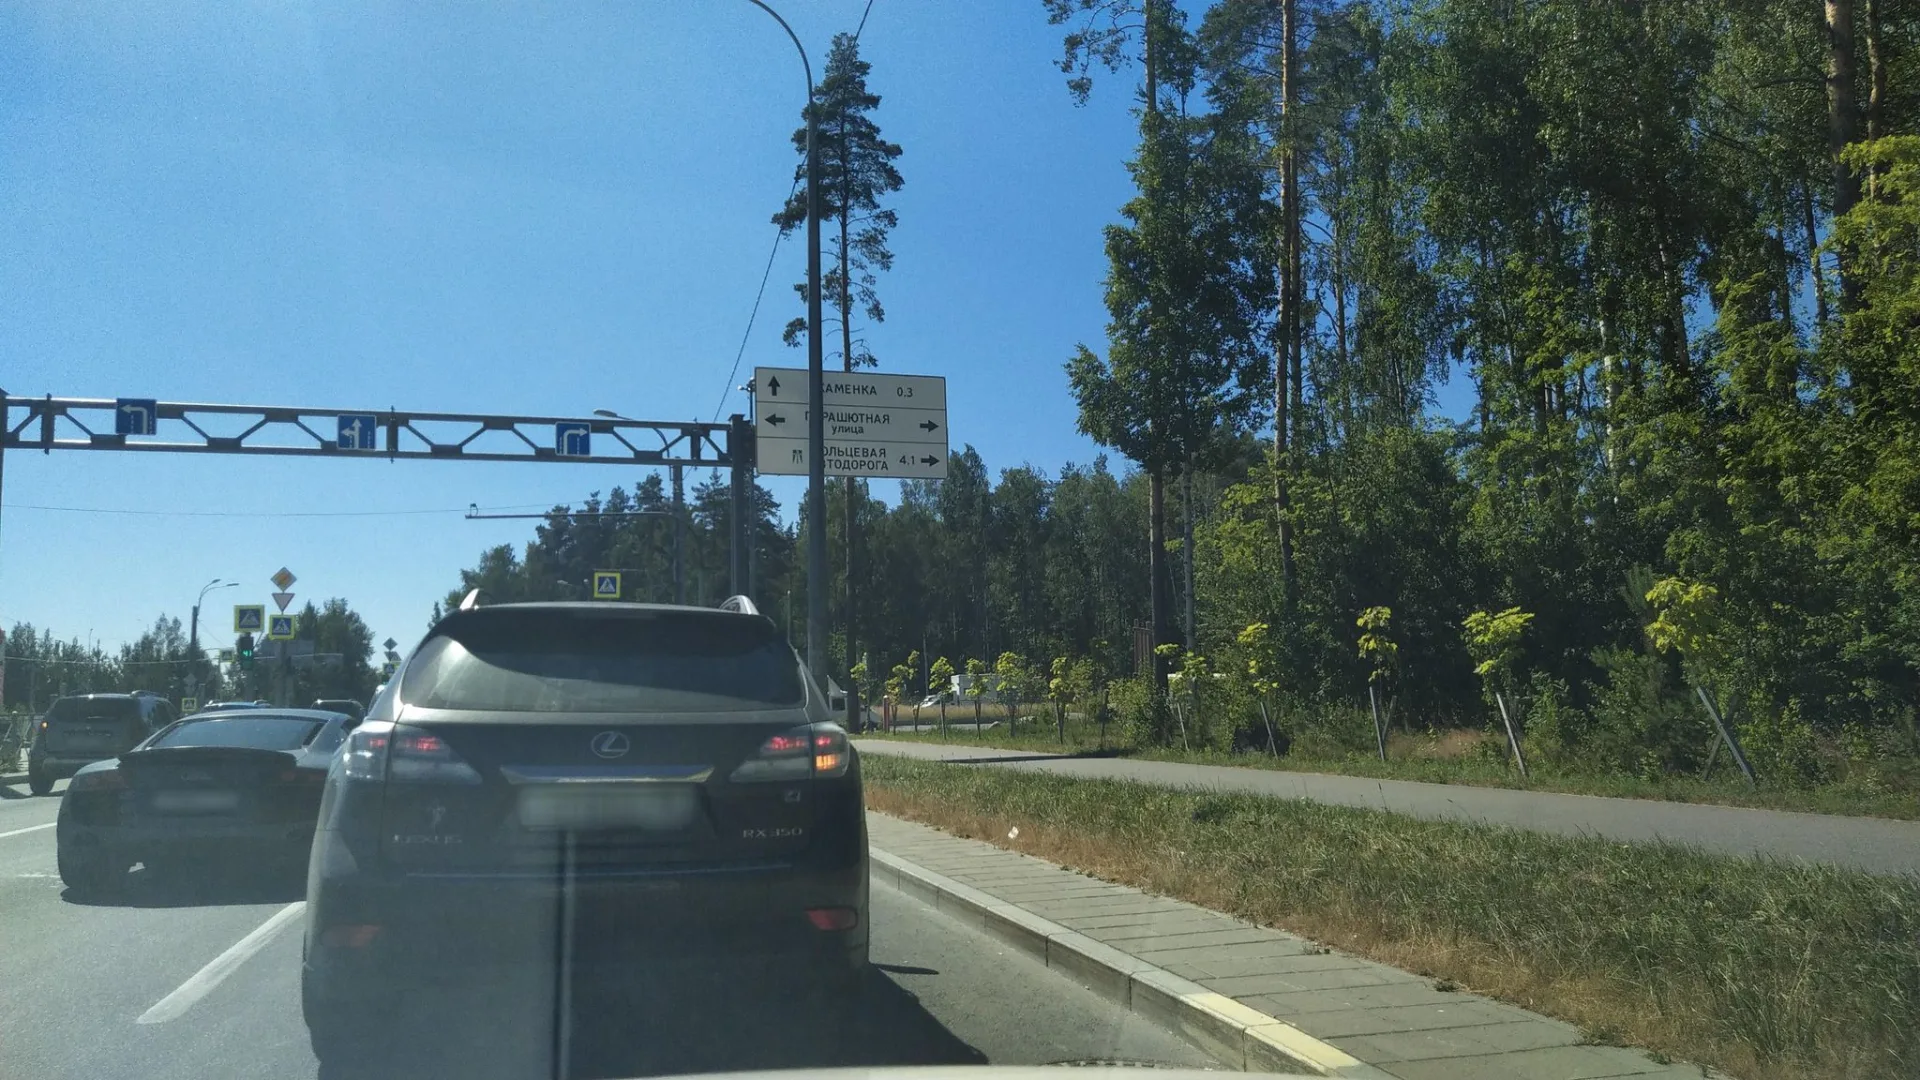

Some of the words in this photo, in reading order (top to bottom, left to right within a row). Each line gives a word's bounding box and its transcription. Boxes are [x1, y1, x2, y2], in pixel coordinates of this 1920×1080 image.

[820, 383, 877, 396] АМЕНКА
[897, 387, 913, 398] 0.3
[805, 411, 890, 424] ПРАШЮТНАЯ
[831, 425, 864, 435] улица
[822, 446, 886, 458] ОЛЬЦЕВАЯ
[899, 456, 915, 465] 4.1
[823, 459, 888, 471] ТОДОРОГА
